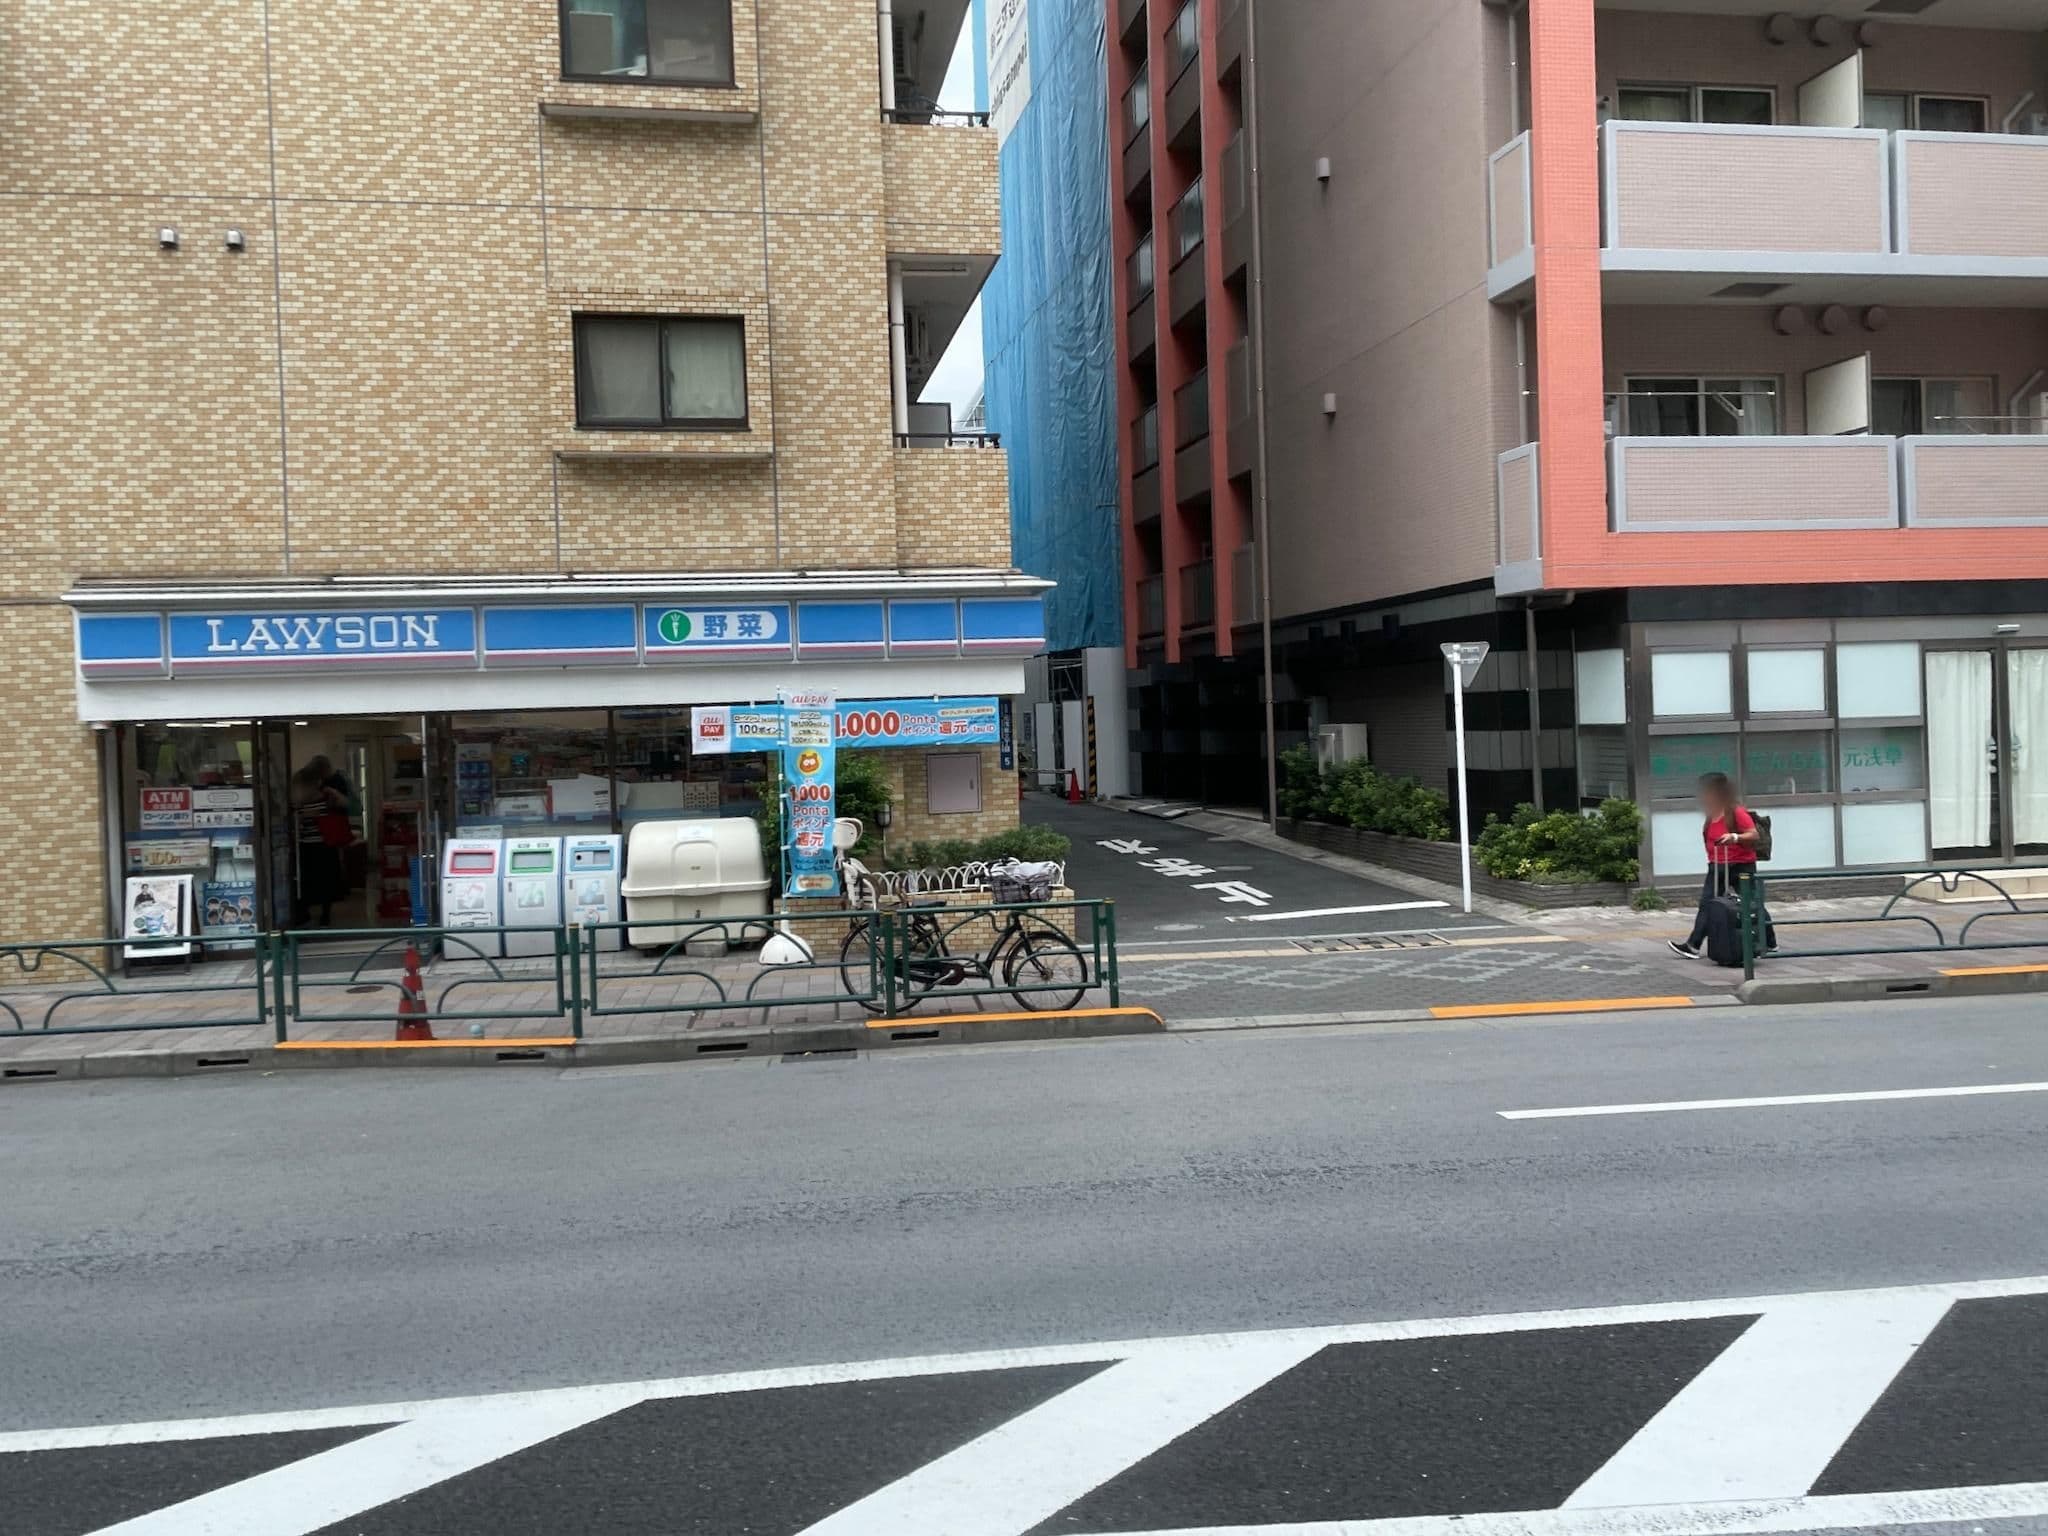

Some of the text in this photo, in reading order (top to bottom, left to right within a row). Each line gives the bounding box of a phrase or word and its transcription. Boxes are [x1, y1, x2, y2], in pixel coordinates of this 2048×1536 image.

[703, 613, 763, 638] 野菜
[206, 615, 440, 652] LAWSON
[703, 716, 721, 724] au
[835, 711, 900, 737] 1,000
[903, 715, 936, 724] Ponta
[703, 725, 721, 734] PAY
[903, 726, 936, 735] ポイント
[939, 720, 968, 734] 還元
[148, 791, 184, 803] ATM
[793, 805, 829, 816] Ponta
[793, 819, 830, 829] ポイント
[796, 832, 825, 847] 還元
[1095, 837, 1274, 907] 止まれ
